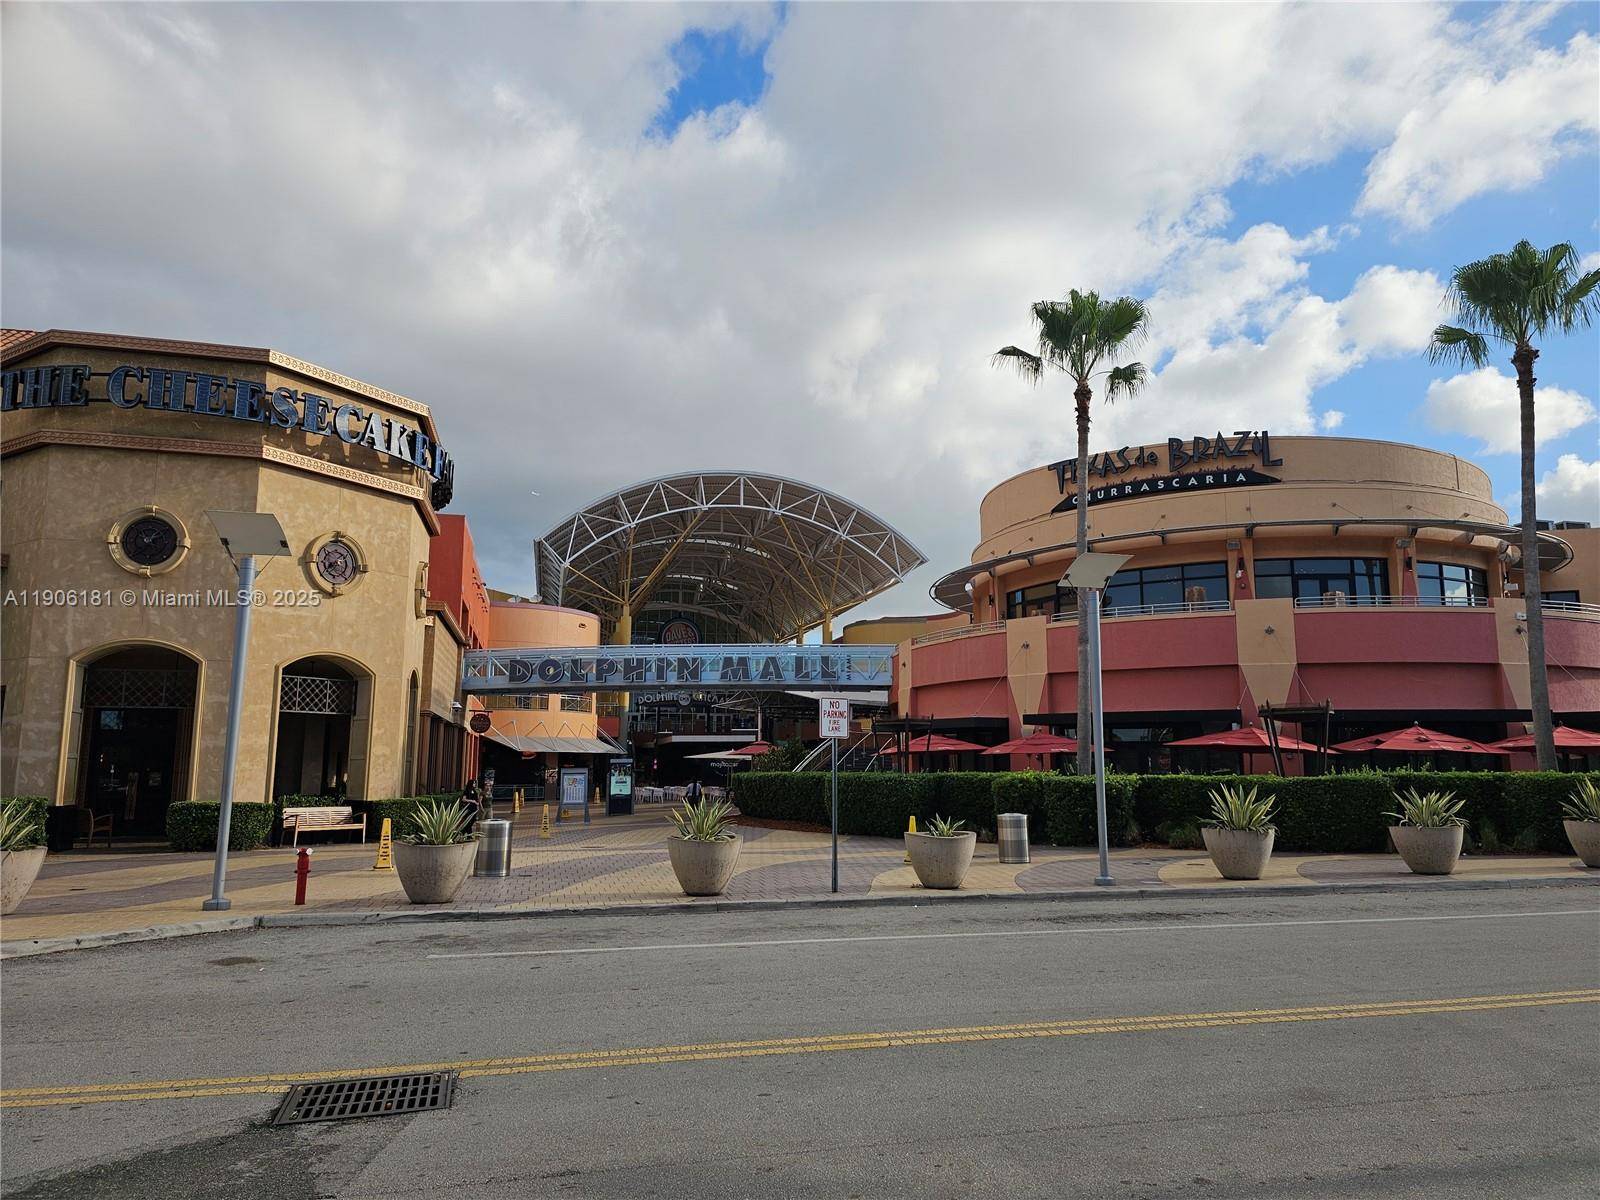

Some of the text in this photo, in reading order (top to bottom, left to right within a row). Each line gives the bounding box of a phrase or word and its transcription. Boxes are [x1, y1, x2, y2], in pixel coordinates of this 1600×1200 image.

[0, 364, 430, 472] THE CHEESECAKE
[1048, 445, 1131, 494] TEXAS
[1134, 446, 1158, 468] de
[1072, 472, 1247, 504] CHURRASCARIA
[508, 656, 839, 683] DOLPHIN MALL
[823, 710, 848, 719] PARKING
[829, 700, 841, 710] NO
